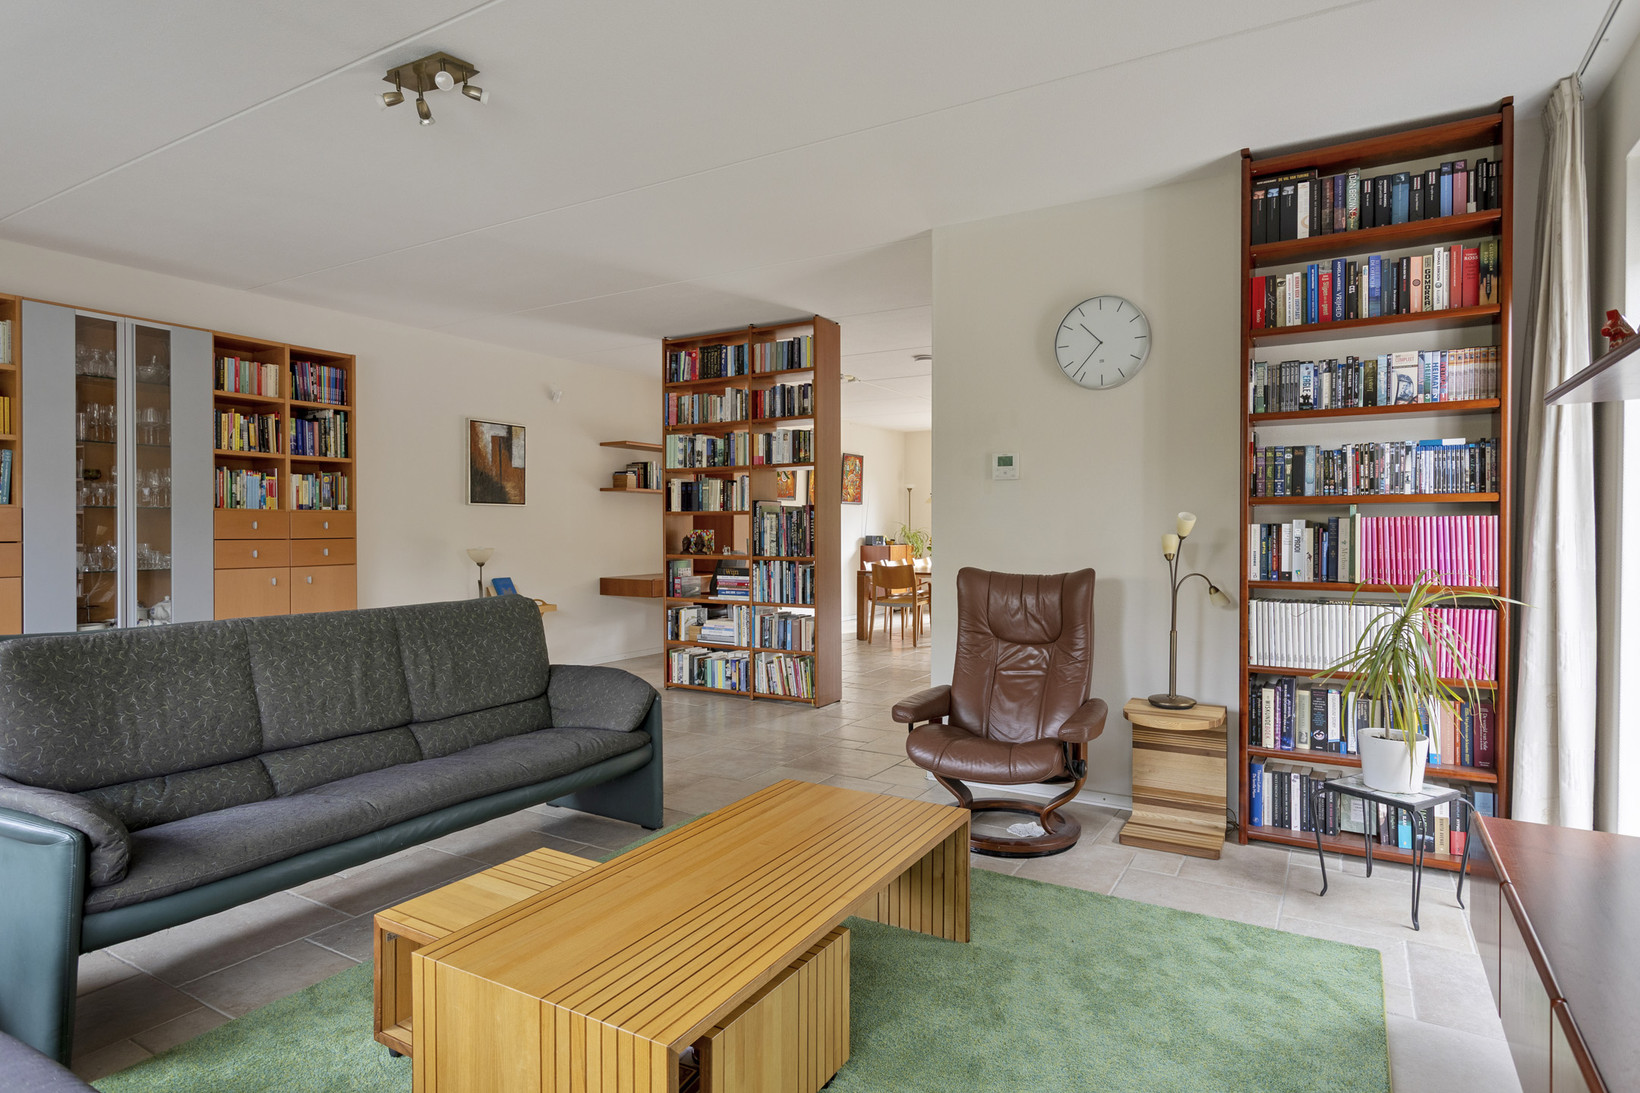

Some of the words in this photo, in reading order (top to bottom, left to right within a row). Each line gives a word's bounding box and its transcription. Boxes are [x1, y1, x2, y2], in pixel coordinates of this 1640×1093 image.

[1349, 175, 1357, 188] DAN
[1349, 189, 1357, 213] BROWN
[1334, 292, 1342, 318] VRIJHEID
[1302, 375, 1311, 393] EAGLE
[1340, 547, 1348, 570] Mythos
